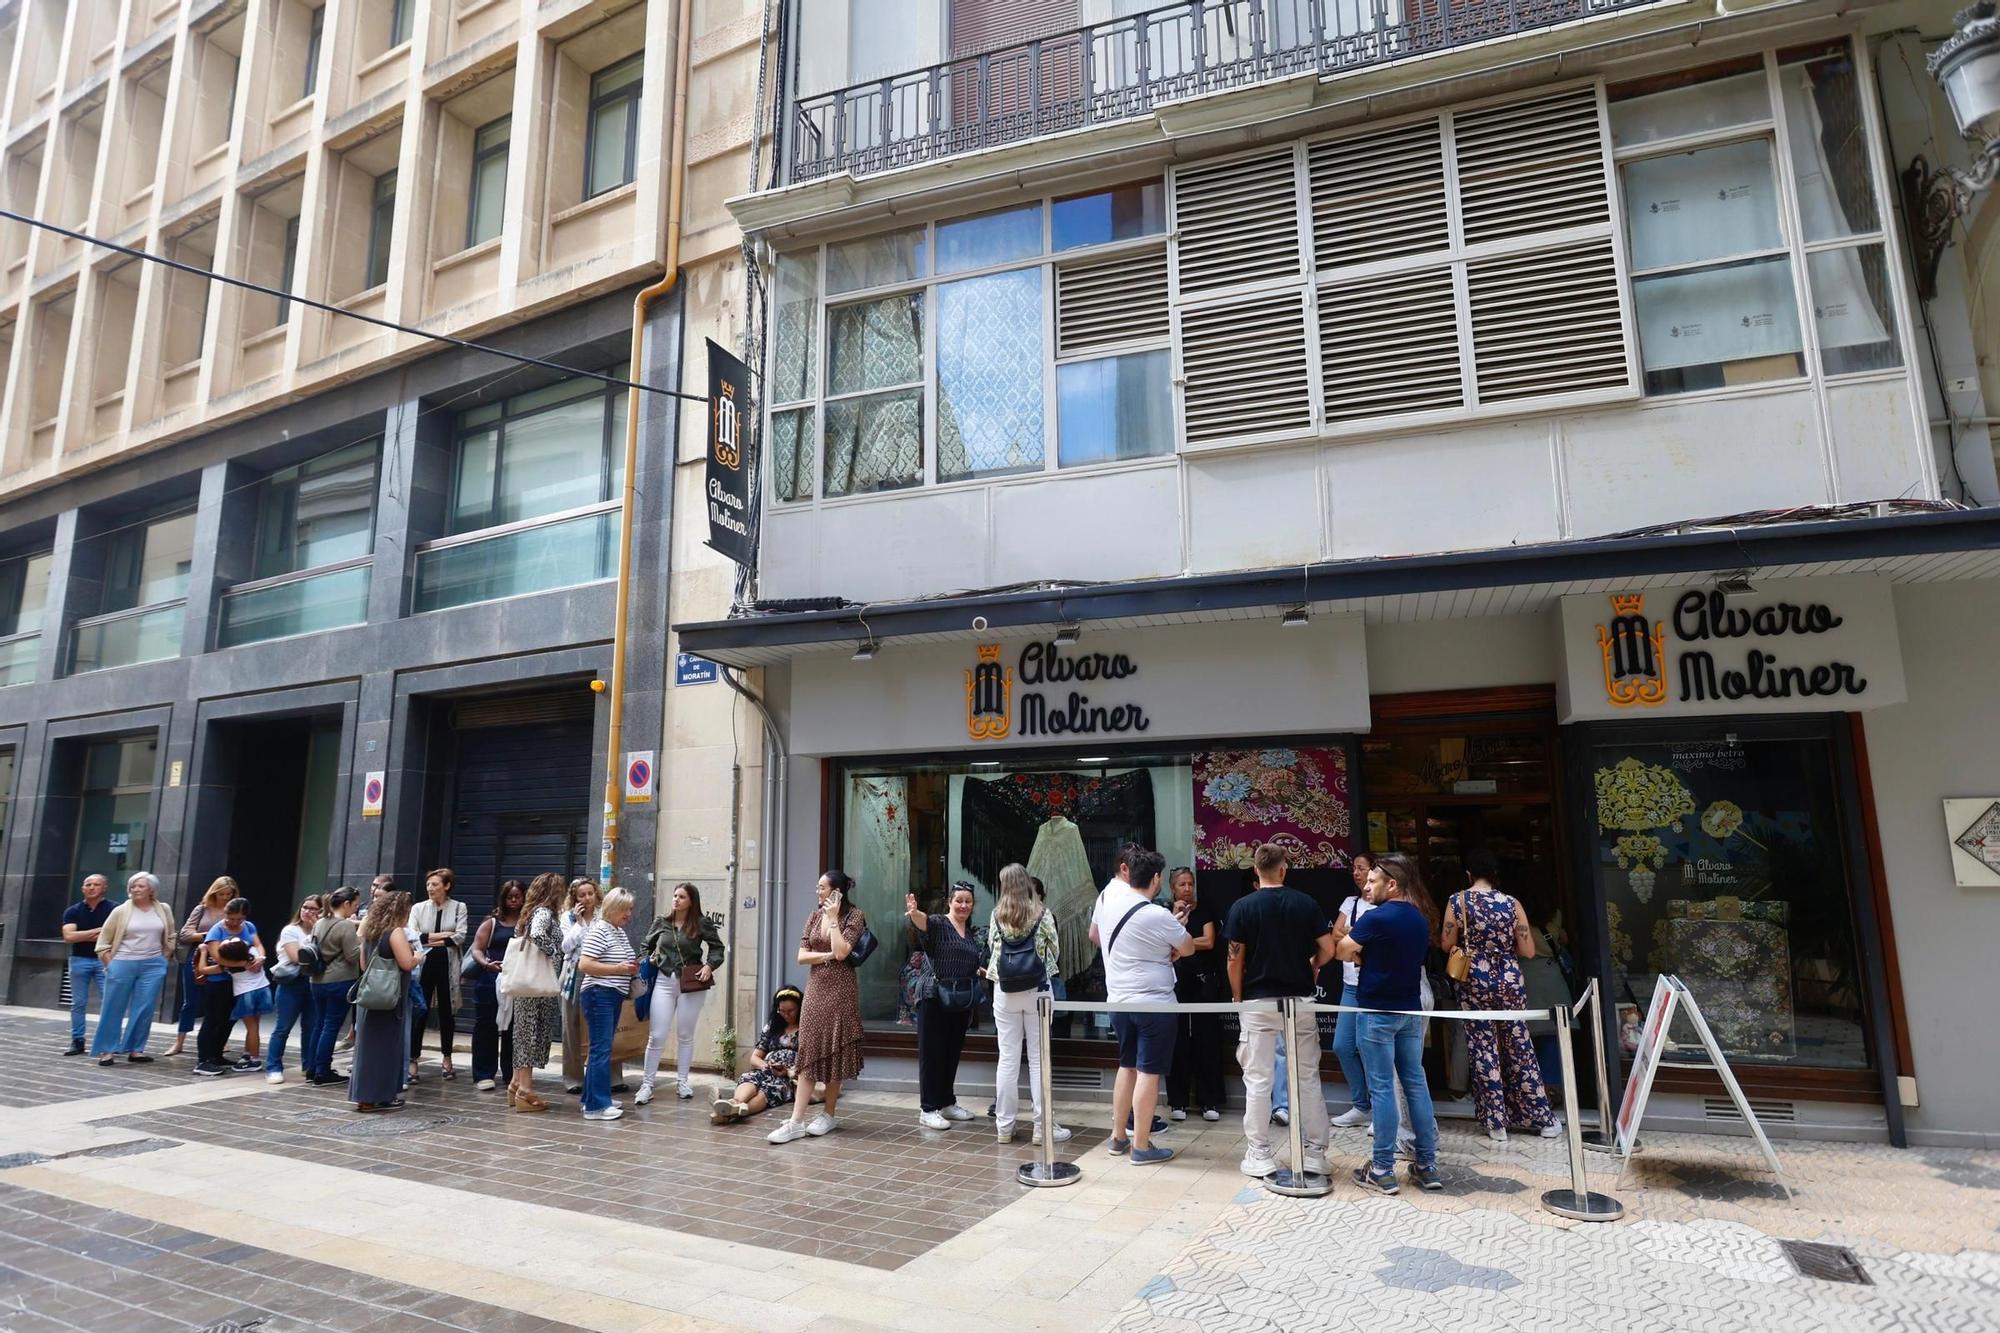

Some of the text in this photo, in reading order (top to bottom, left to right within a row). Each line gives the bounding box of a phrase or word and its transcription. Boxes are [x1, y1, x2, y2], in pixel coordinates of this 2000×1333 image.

[710, 501, 748, 536] Moliner
[1678, 649, 1867, 702] Moliner
[1017, 691, 1150, 735] Moliner
[1698, 872, 1738, 884] Moliner
